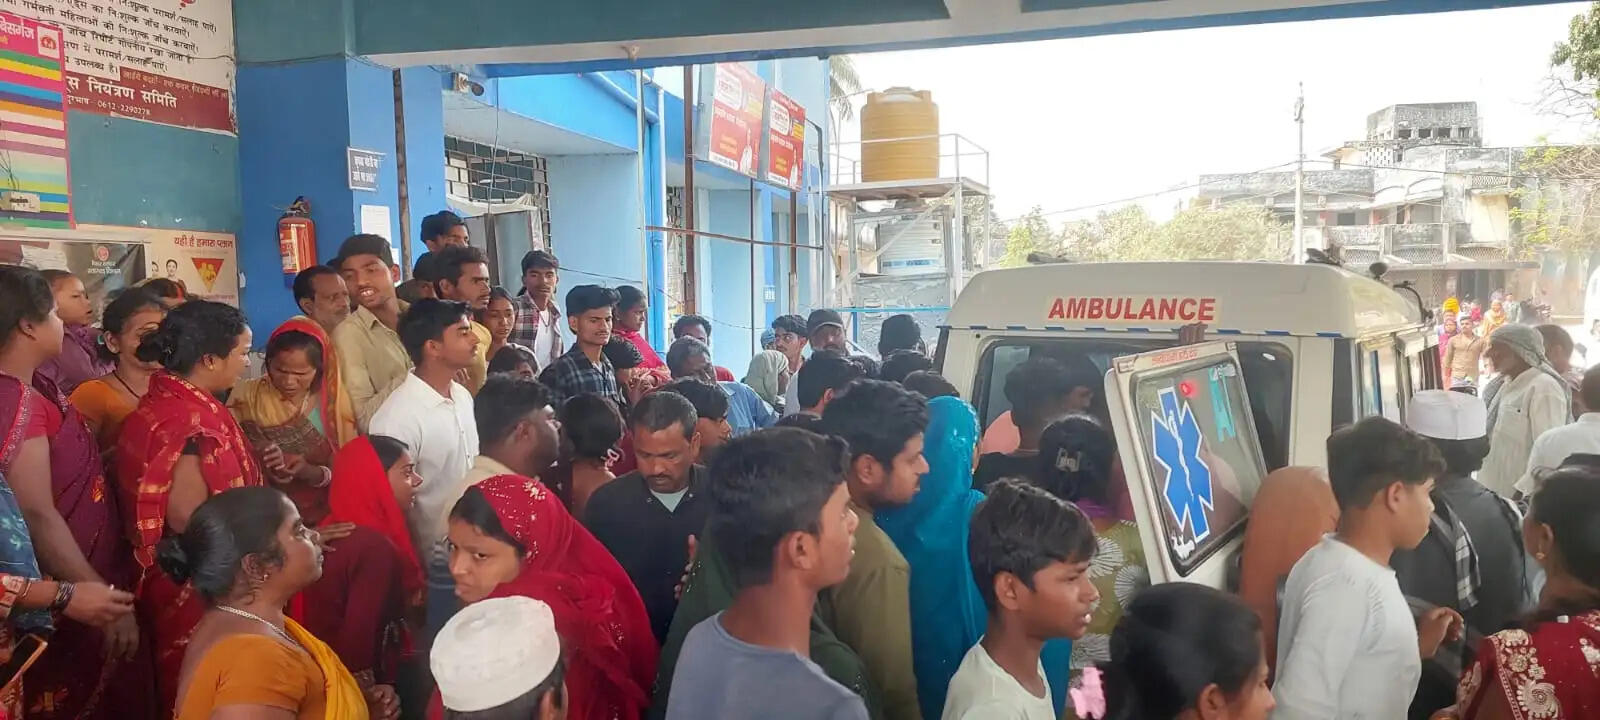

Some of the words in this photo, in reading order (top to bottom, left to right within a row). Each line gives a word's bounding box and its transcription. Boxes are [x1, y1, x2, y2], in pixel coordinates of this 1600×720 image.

[86, 76, 136, 101] नियंत्रण
[140, 89, 178, 109] समिति
[1048, 297, 1217, 322] AMBULANCE
